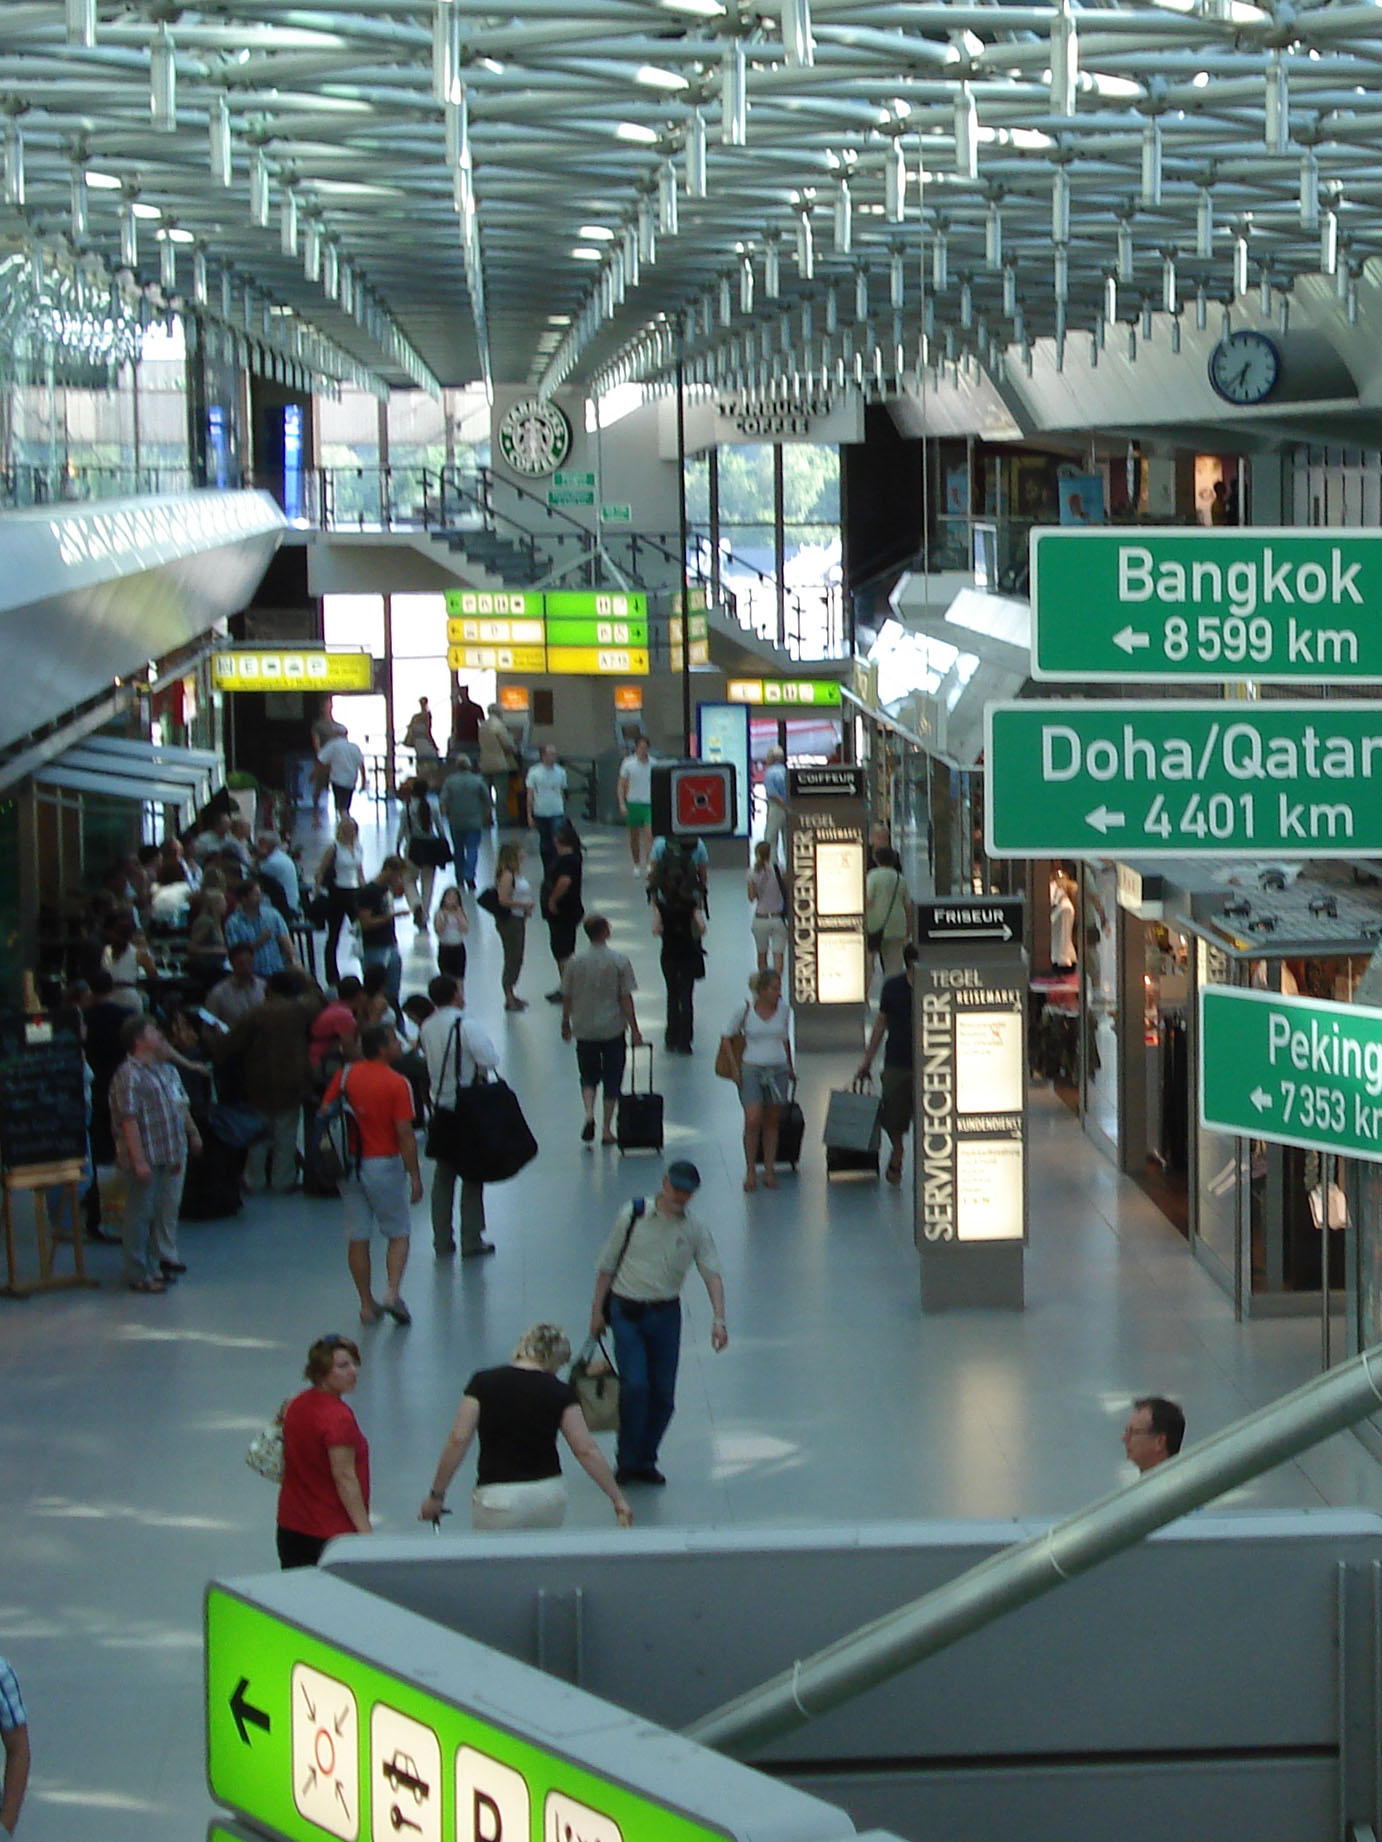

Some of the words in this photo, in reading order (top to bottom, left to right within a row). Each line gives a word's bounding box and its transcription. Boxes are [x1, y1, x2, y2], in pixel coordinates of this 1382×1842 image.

[1118, 546, 1364, 617] Bangkok
[1288, 618, 1358, 663] km
[797, 772, 856, 784] COIFFEUR
[1280, 793, 1354, 838] km
[794, 829, 816, 1004] SERVICECENTER
[933, 907, 1004, 925] FRISEUR
[930, 969, 983, 988] TEGEL
[955, 989, 1021, 1005] REISEMARKT
[922, 992, 953, 1242] SERVICECENTER
[956, 1116, 1021, 1132] KUNDENDIENST
